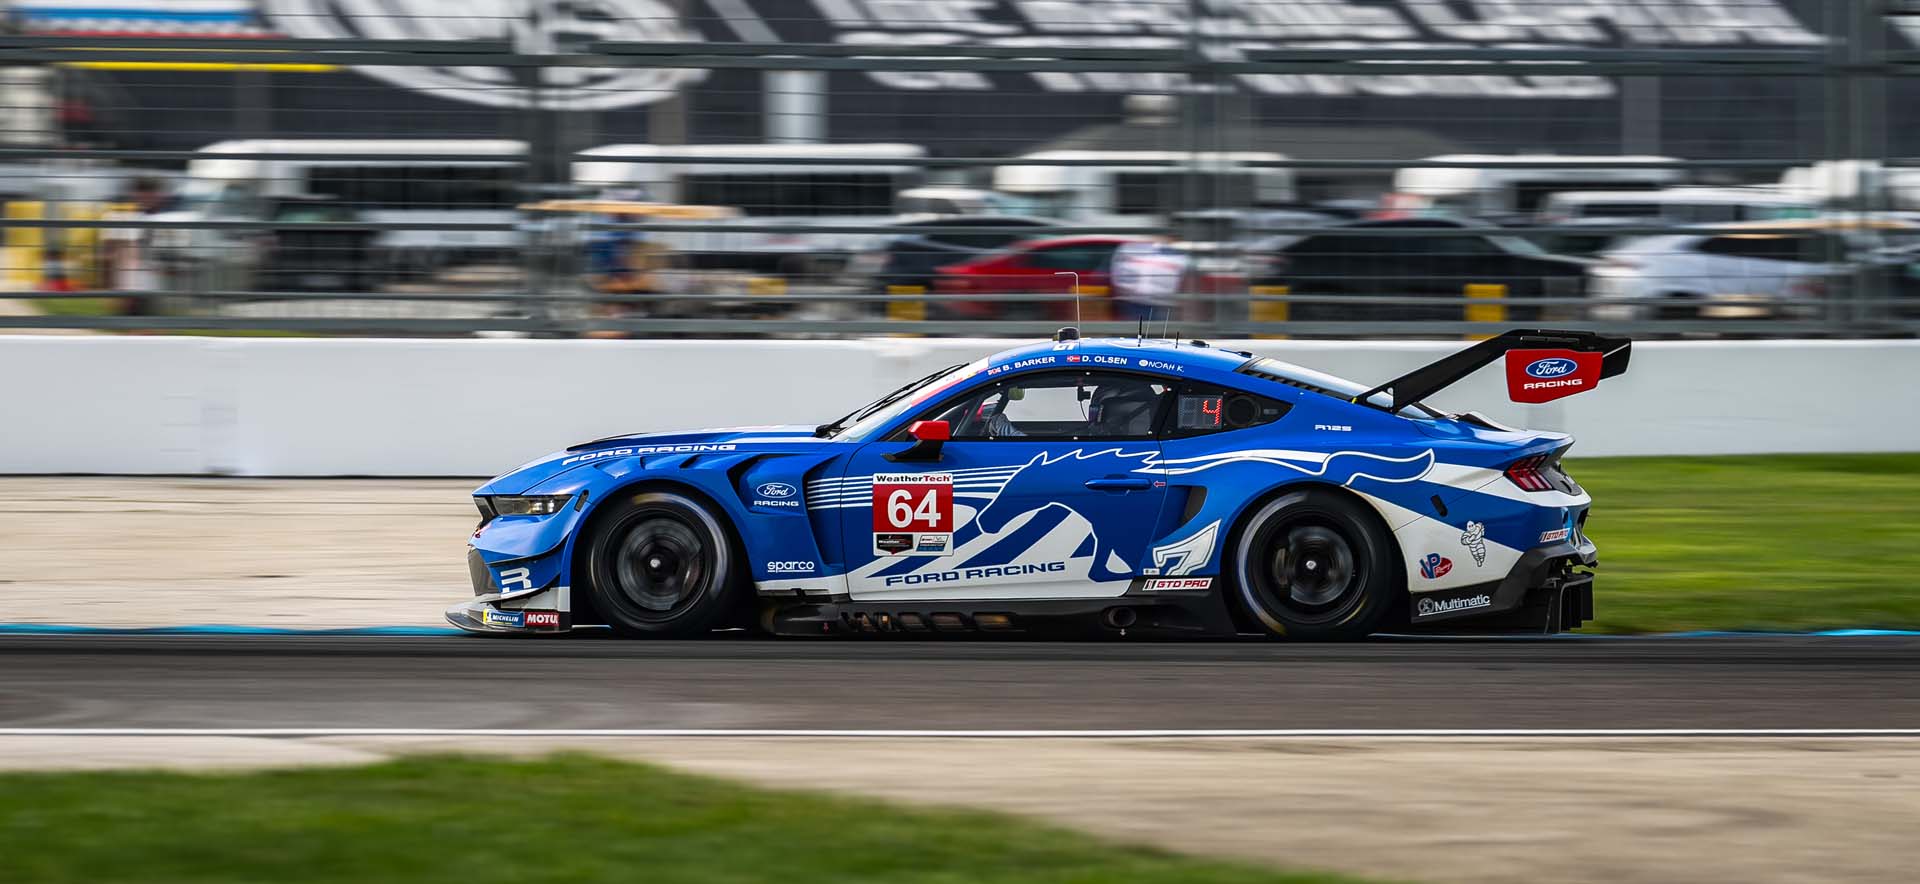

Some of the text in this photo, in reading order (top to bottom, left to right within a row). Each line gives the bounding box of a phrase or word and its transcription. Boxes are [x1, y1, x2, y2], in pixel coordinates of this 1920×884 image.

[1014, 356, 1056, 369] BARKER
[1082, 355, 1128, 365] D. OLSEN
[1148, 360, 1175, 370] NOAH
[1535, 360, 1568, 375] Ford
[1523, 378, 1583, 390] RACING
[1203, 399, 1222, 426] 4
[562, 444, 737, 466] FORD RACING
[763, 484, 788, 496] Ford
[887, 489, 942, 528] 64
[767, 561, 815, 573] sparco
[1419, 552, 1441, 579] VP
[885, 561, 1066, 587] FORD RACING
[1156, 579, 1209, 588] GTD PRO
[1434, 594, 1490, 612] Multimatic
[492, 614, 519, 622] MICHELIN
